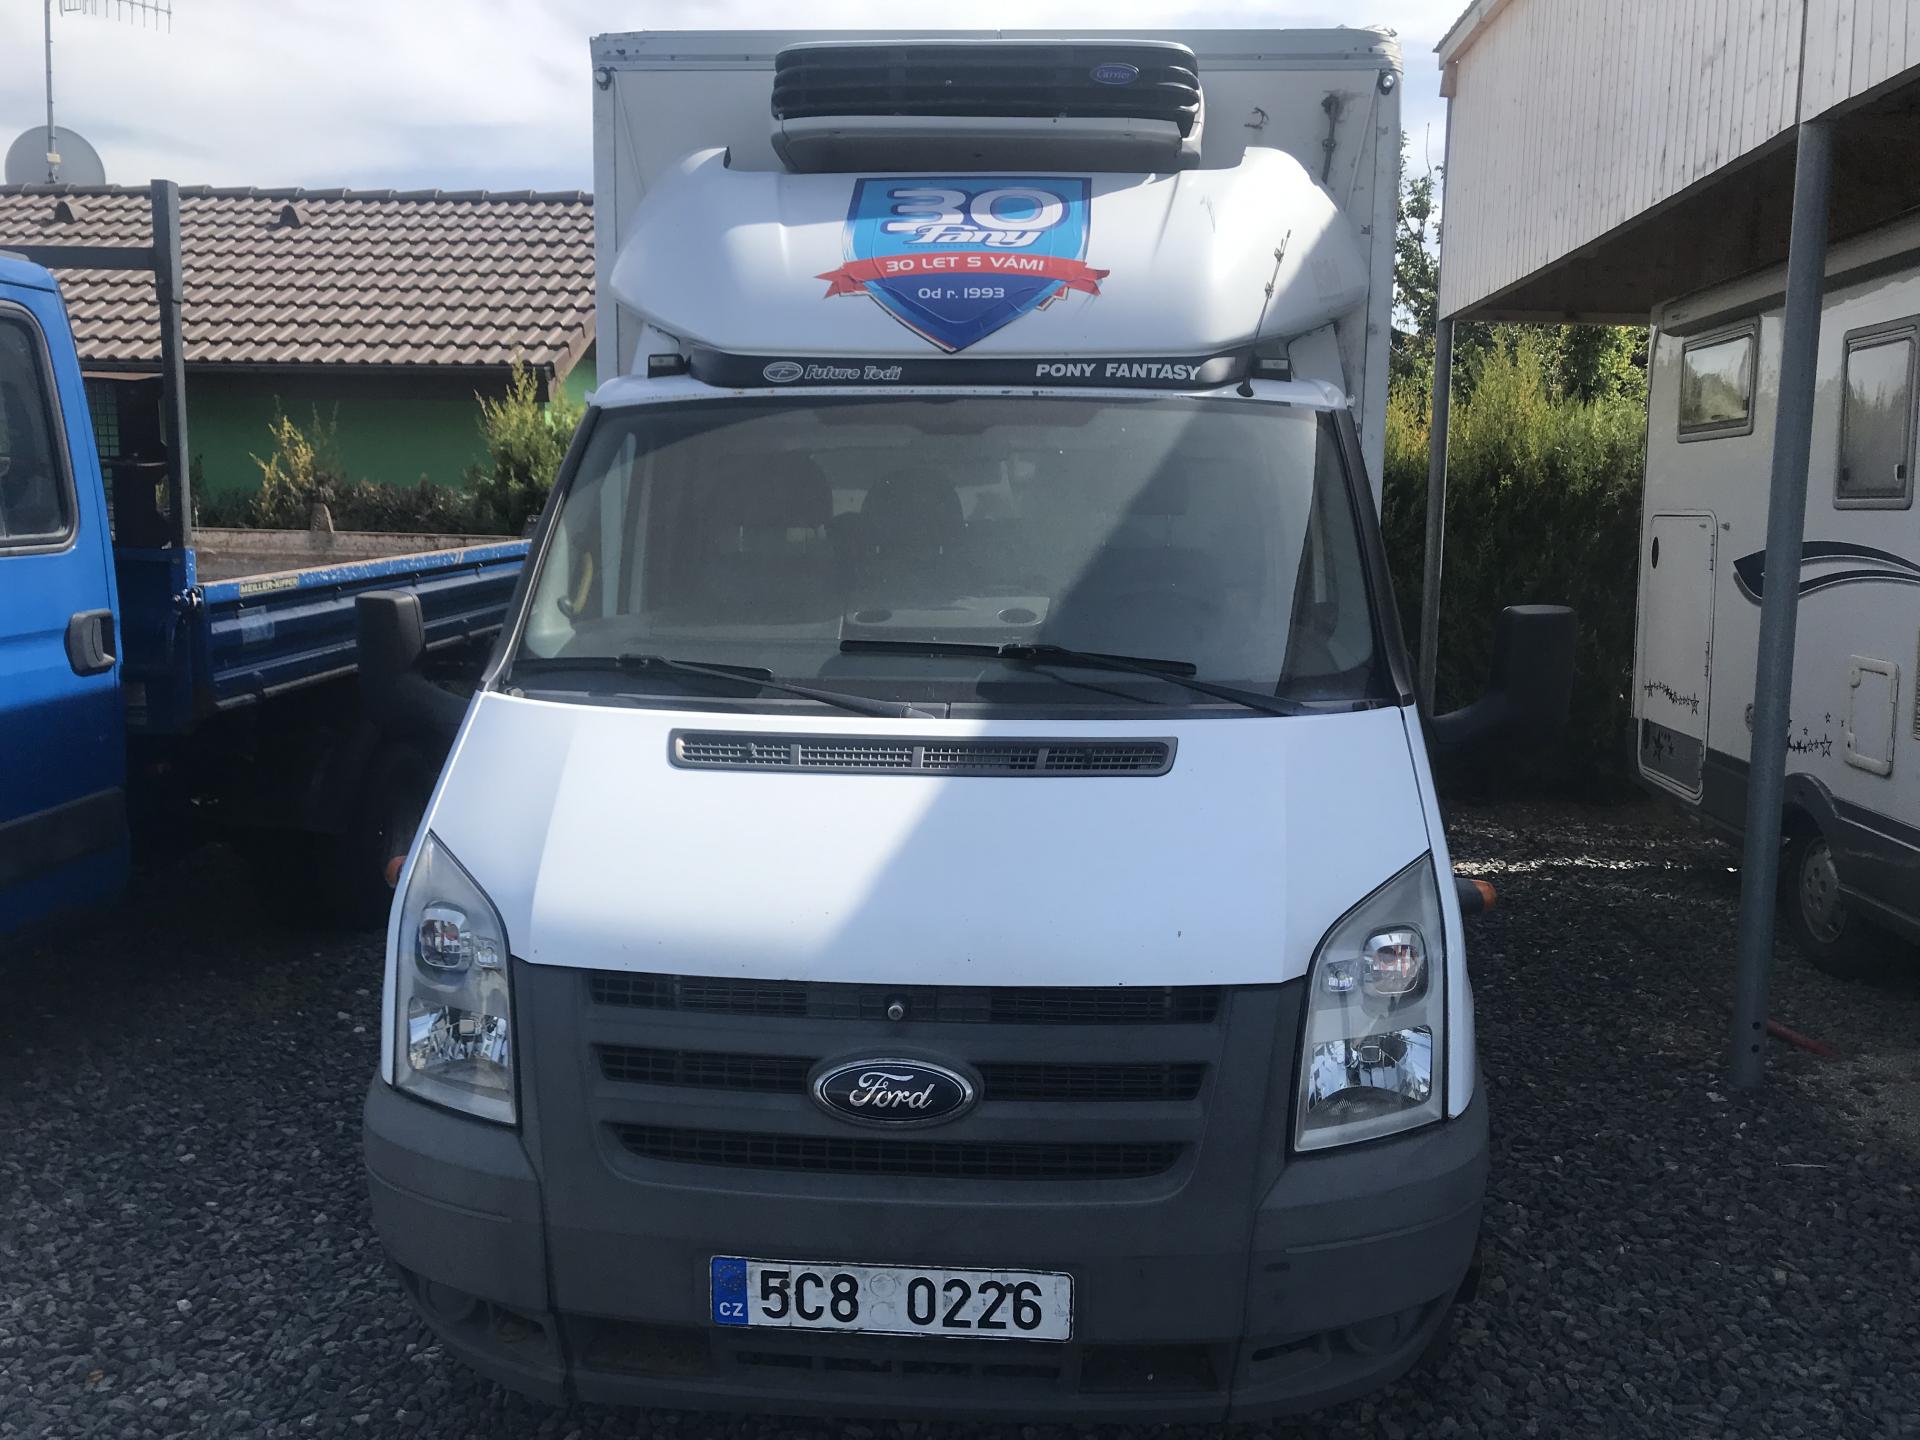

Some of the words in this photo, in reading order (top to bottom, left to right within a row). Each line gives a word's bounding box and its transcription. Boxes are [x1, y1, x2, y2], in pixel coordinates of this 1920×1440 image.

[884, 188, 1066, 232] 30
[905, 224, 1045, 248] Fany
[886, 259, 915, 272] 30
[921, 256, 959, 269] LET
[967, 256, 982, 267] S
[989, 255, 1045, 271] VÁMI
[918, 287, 941, 299] Od
[946, 289, 959, 299] r.
[964, 287, 1005, 299] 1993
[1035, 363, 1097, 377] PONY
[1105, 363, 1201, 381] FANTASY
[849, 1071, 936, 1109] Ford
[719, 1301, 744, 1317] CZ
[760, 1269, 860, 1323] 5C8
[907, 1276, 1043, 1331] 0226
